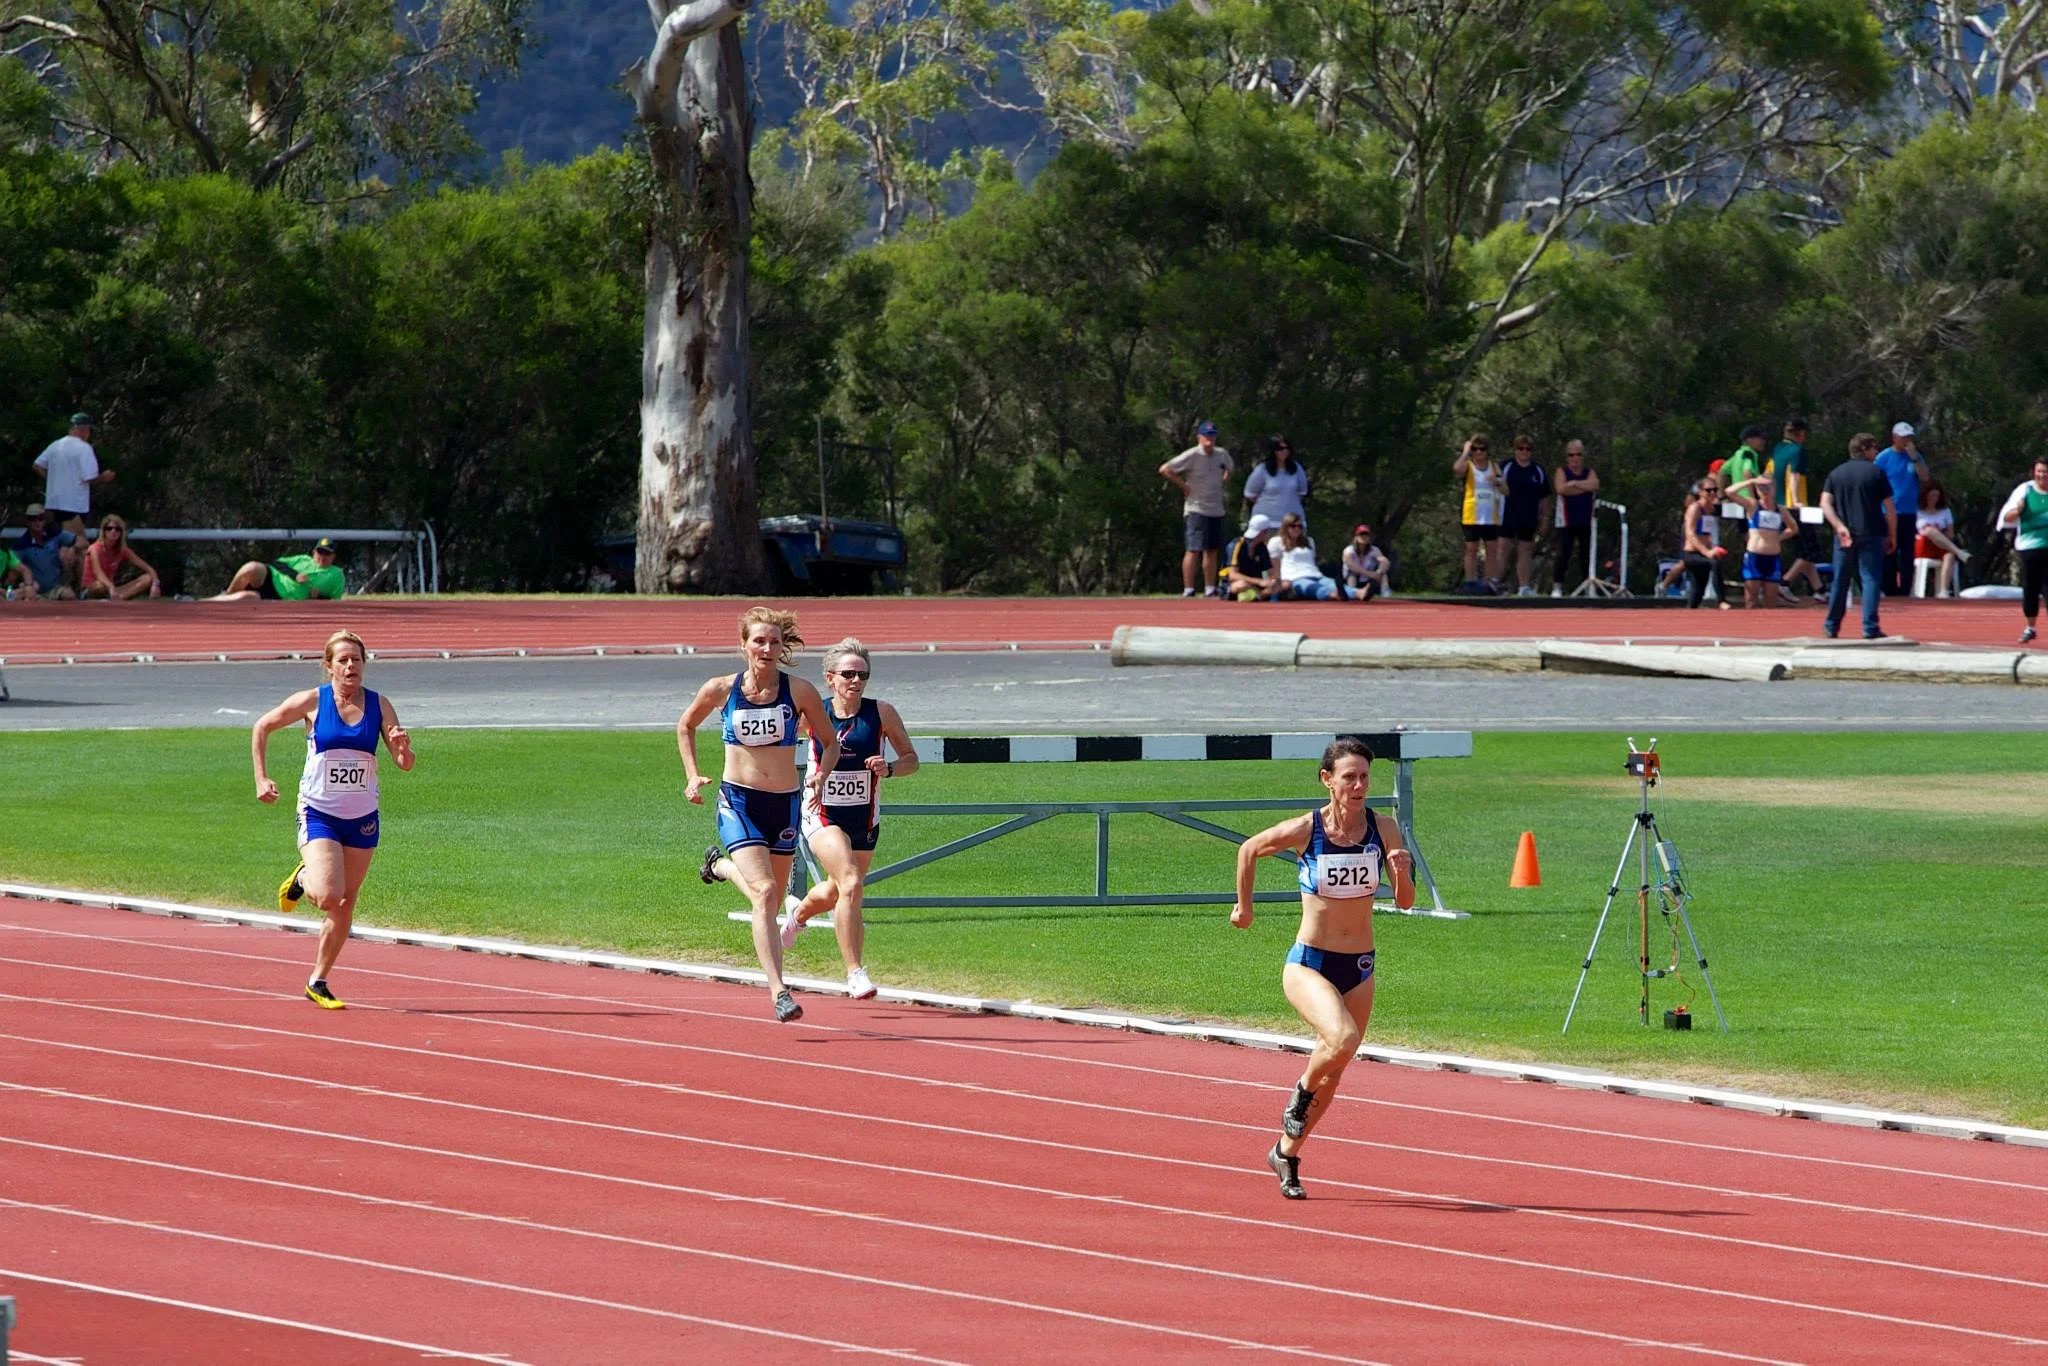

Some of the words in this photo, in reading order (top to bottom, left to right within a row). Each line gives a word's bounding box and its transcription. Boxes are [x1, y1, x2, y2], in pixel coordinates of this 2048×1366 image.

[741, 719, 777, 736] 5215
[330, 768, 365, 784] 5207
[827, 781, 865, 796] 5205
[1327, 867, 1370, 886] 5212
